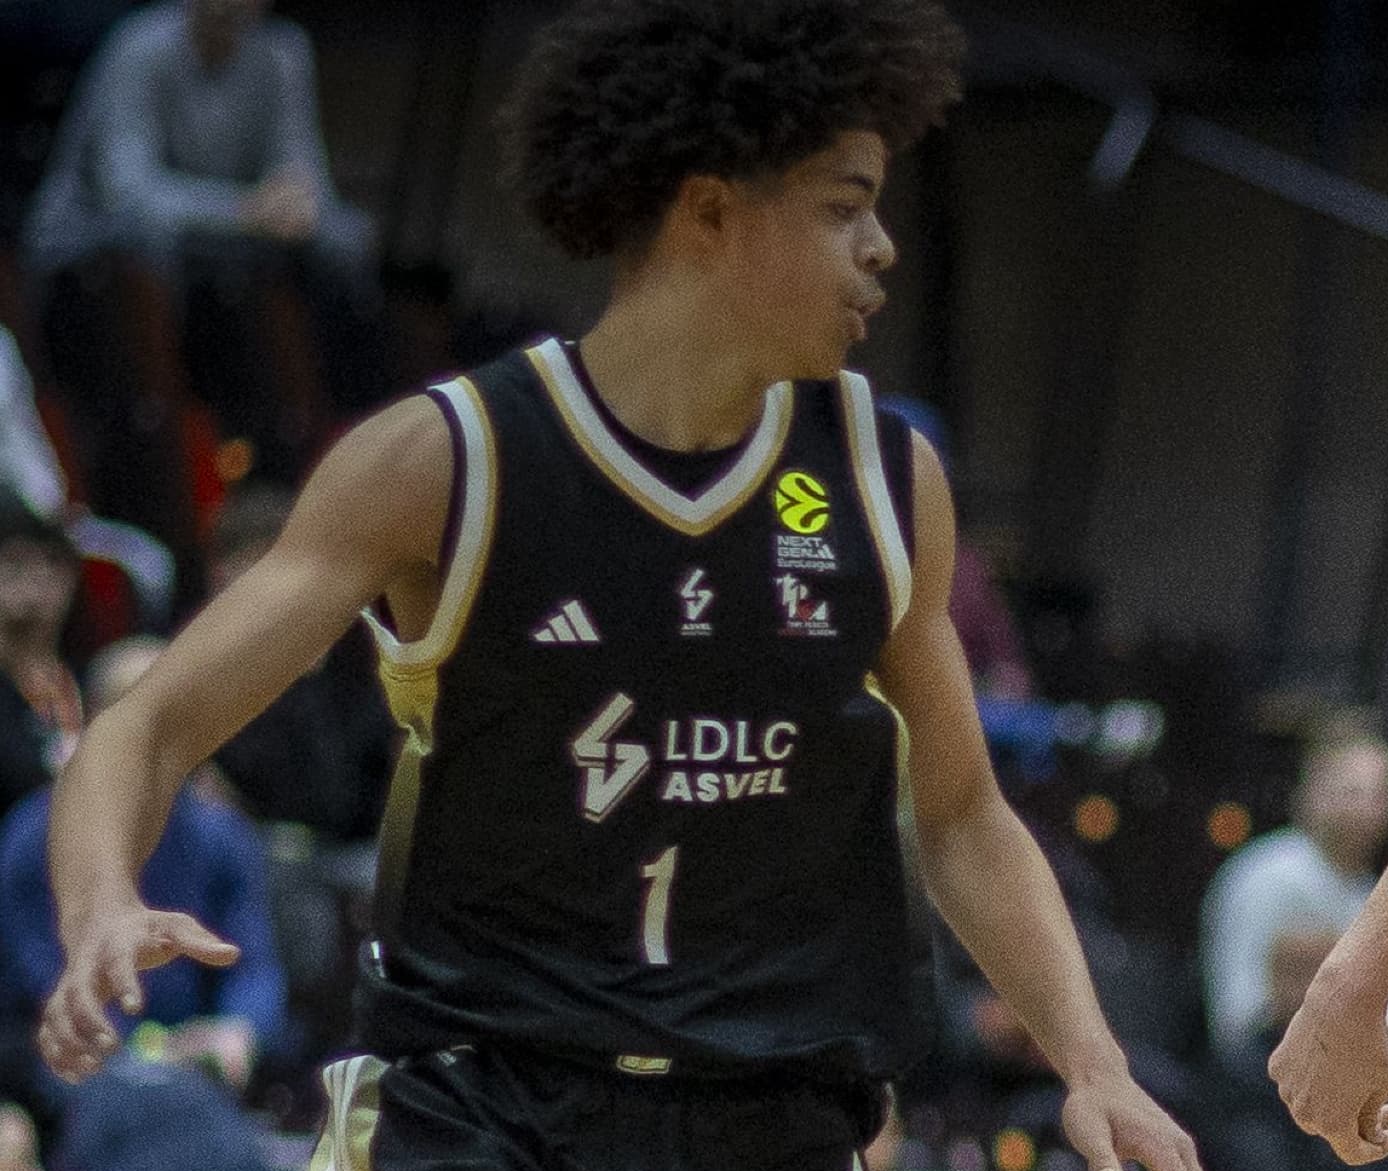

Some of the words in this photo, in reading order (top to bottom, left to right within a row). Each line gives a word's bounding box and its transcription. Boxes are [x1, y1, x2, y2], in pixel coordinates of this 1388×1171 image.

[665, 718, 798, 763] LDLC
[662, 767, 788, 802] ASVEL
[641, 845, 679, 965] 1
